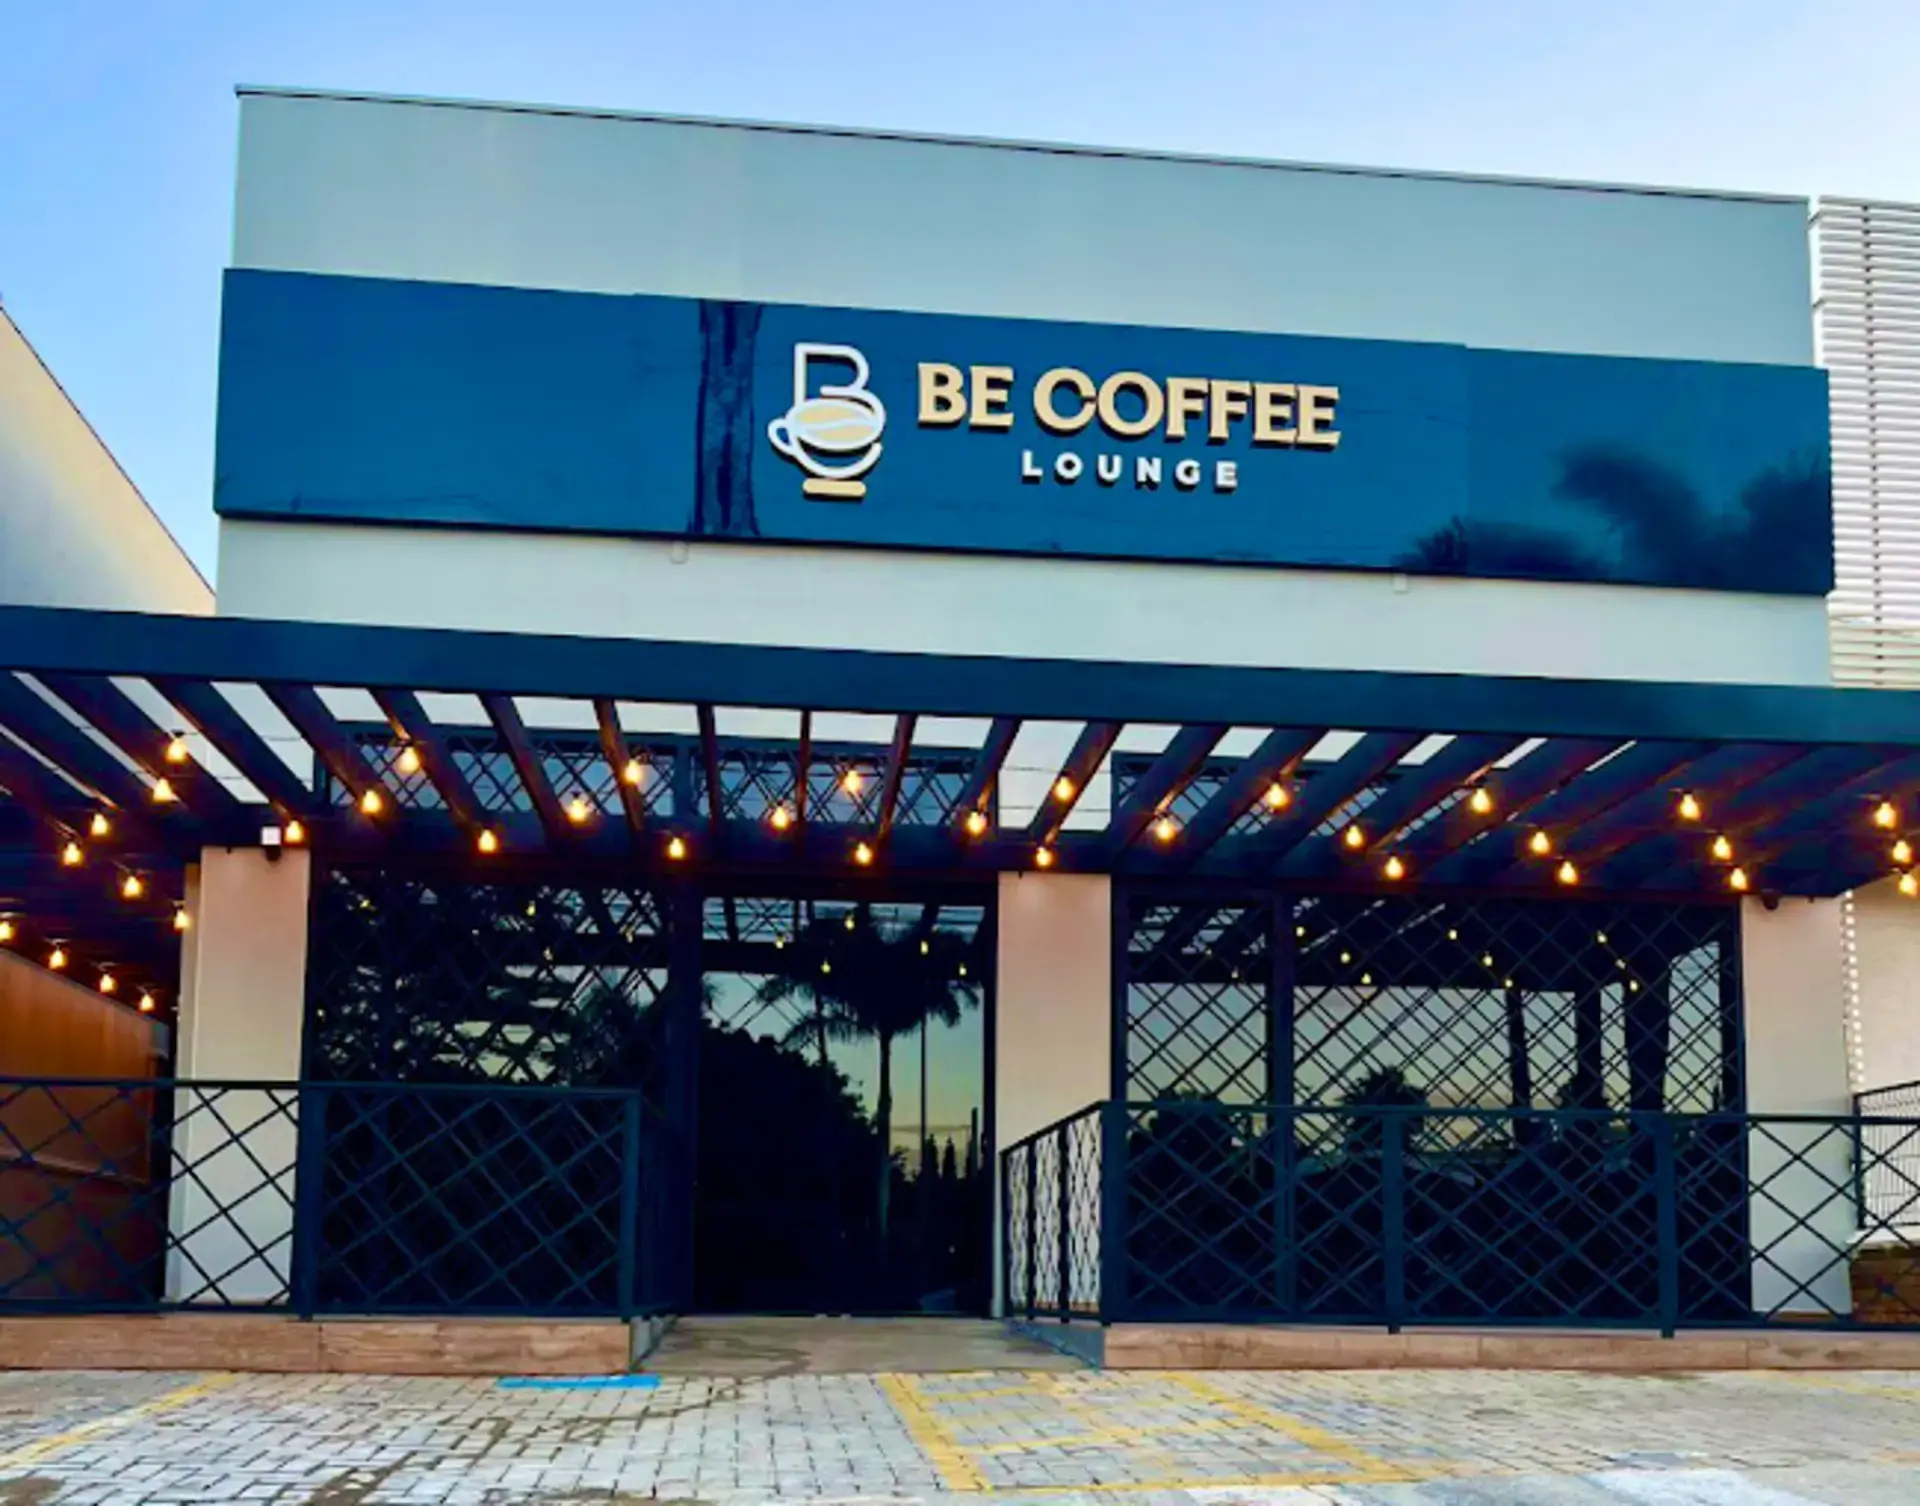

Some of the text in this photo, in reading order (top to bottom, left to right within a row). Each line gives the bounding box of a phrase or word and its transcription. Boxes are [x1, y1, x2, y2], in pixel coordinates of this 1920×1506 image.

[917, 361, 1342, 446] BE COFFEE
[1021, 449, 1240, 489] LOUNGE
